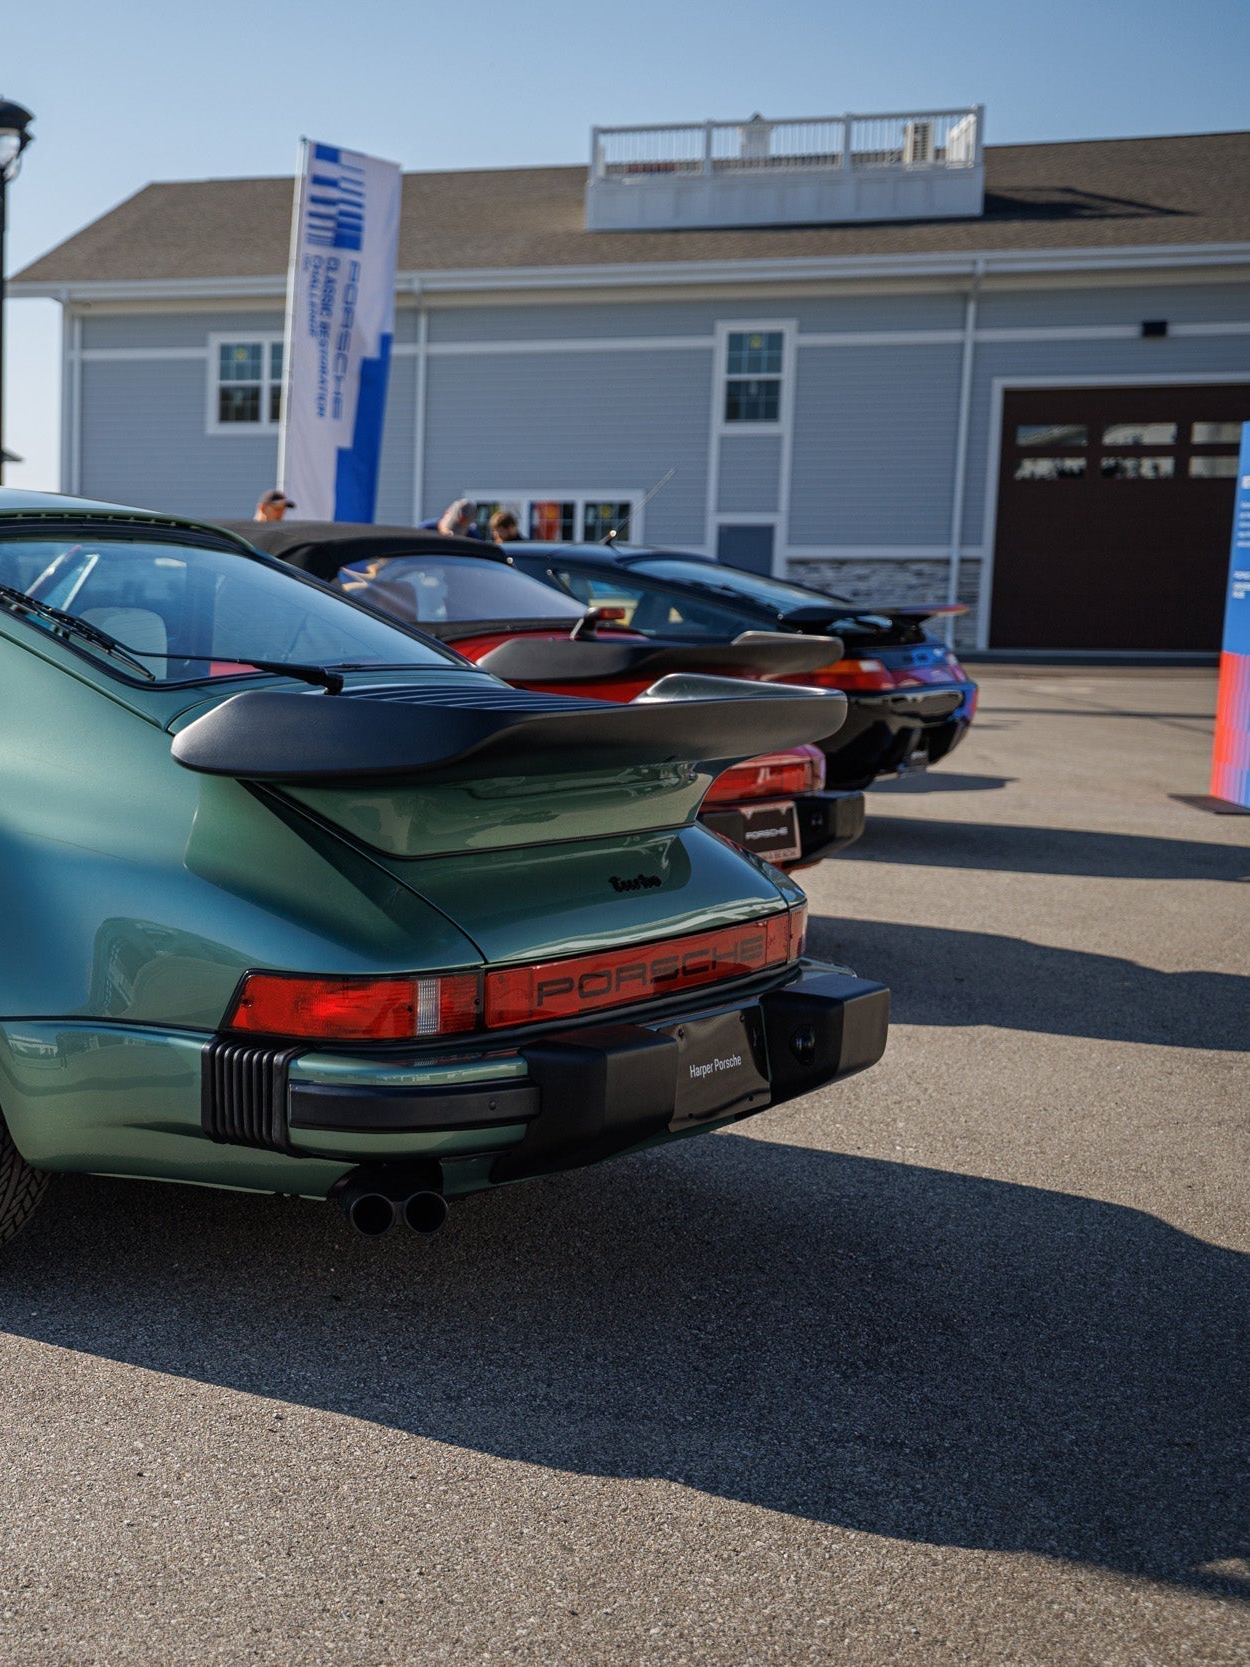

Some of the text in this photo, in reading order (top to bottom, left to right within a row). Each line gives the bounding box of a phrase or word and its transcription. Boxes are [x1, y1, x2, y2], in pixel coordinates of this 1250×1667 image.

[316, 255, 341, 419] CLASSIC RESTORATION
[331, 259, 361, 421] PORSCHE
[745, 826, 788, 841] PORSCHE
[536, 936, 764, 1006] PORSCHE
[689, 1053, 742, 1079] Harper Porsche
